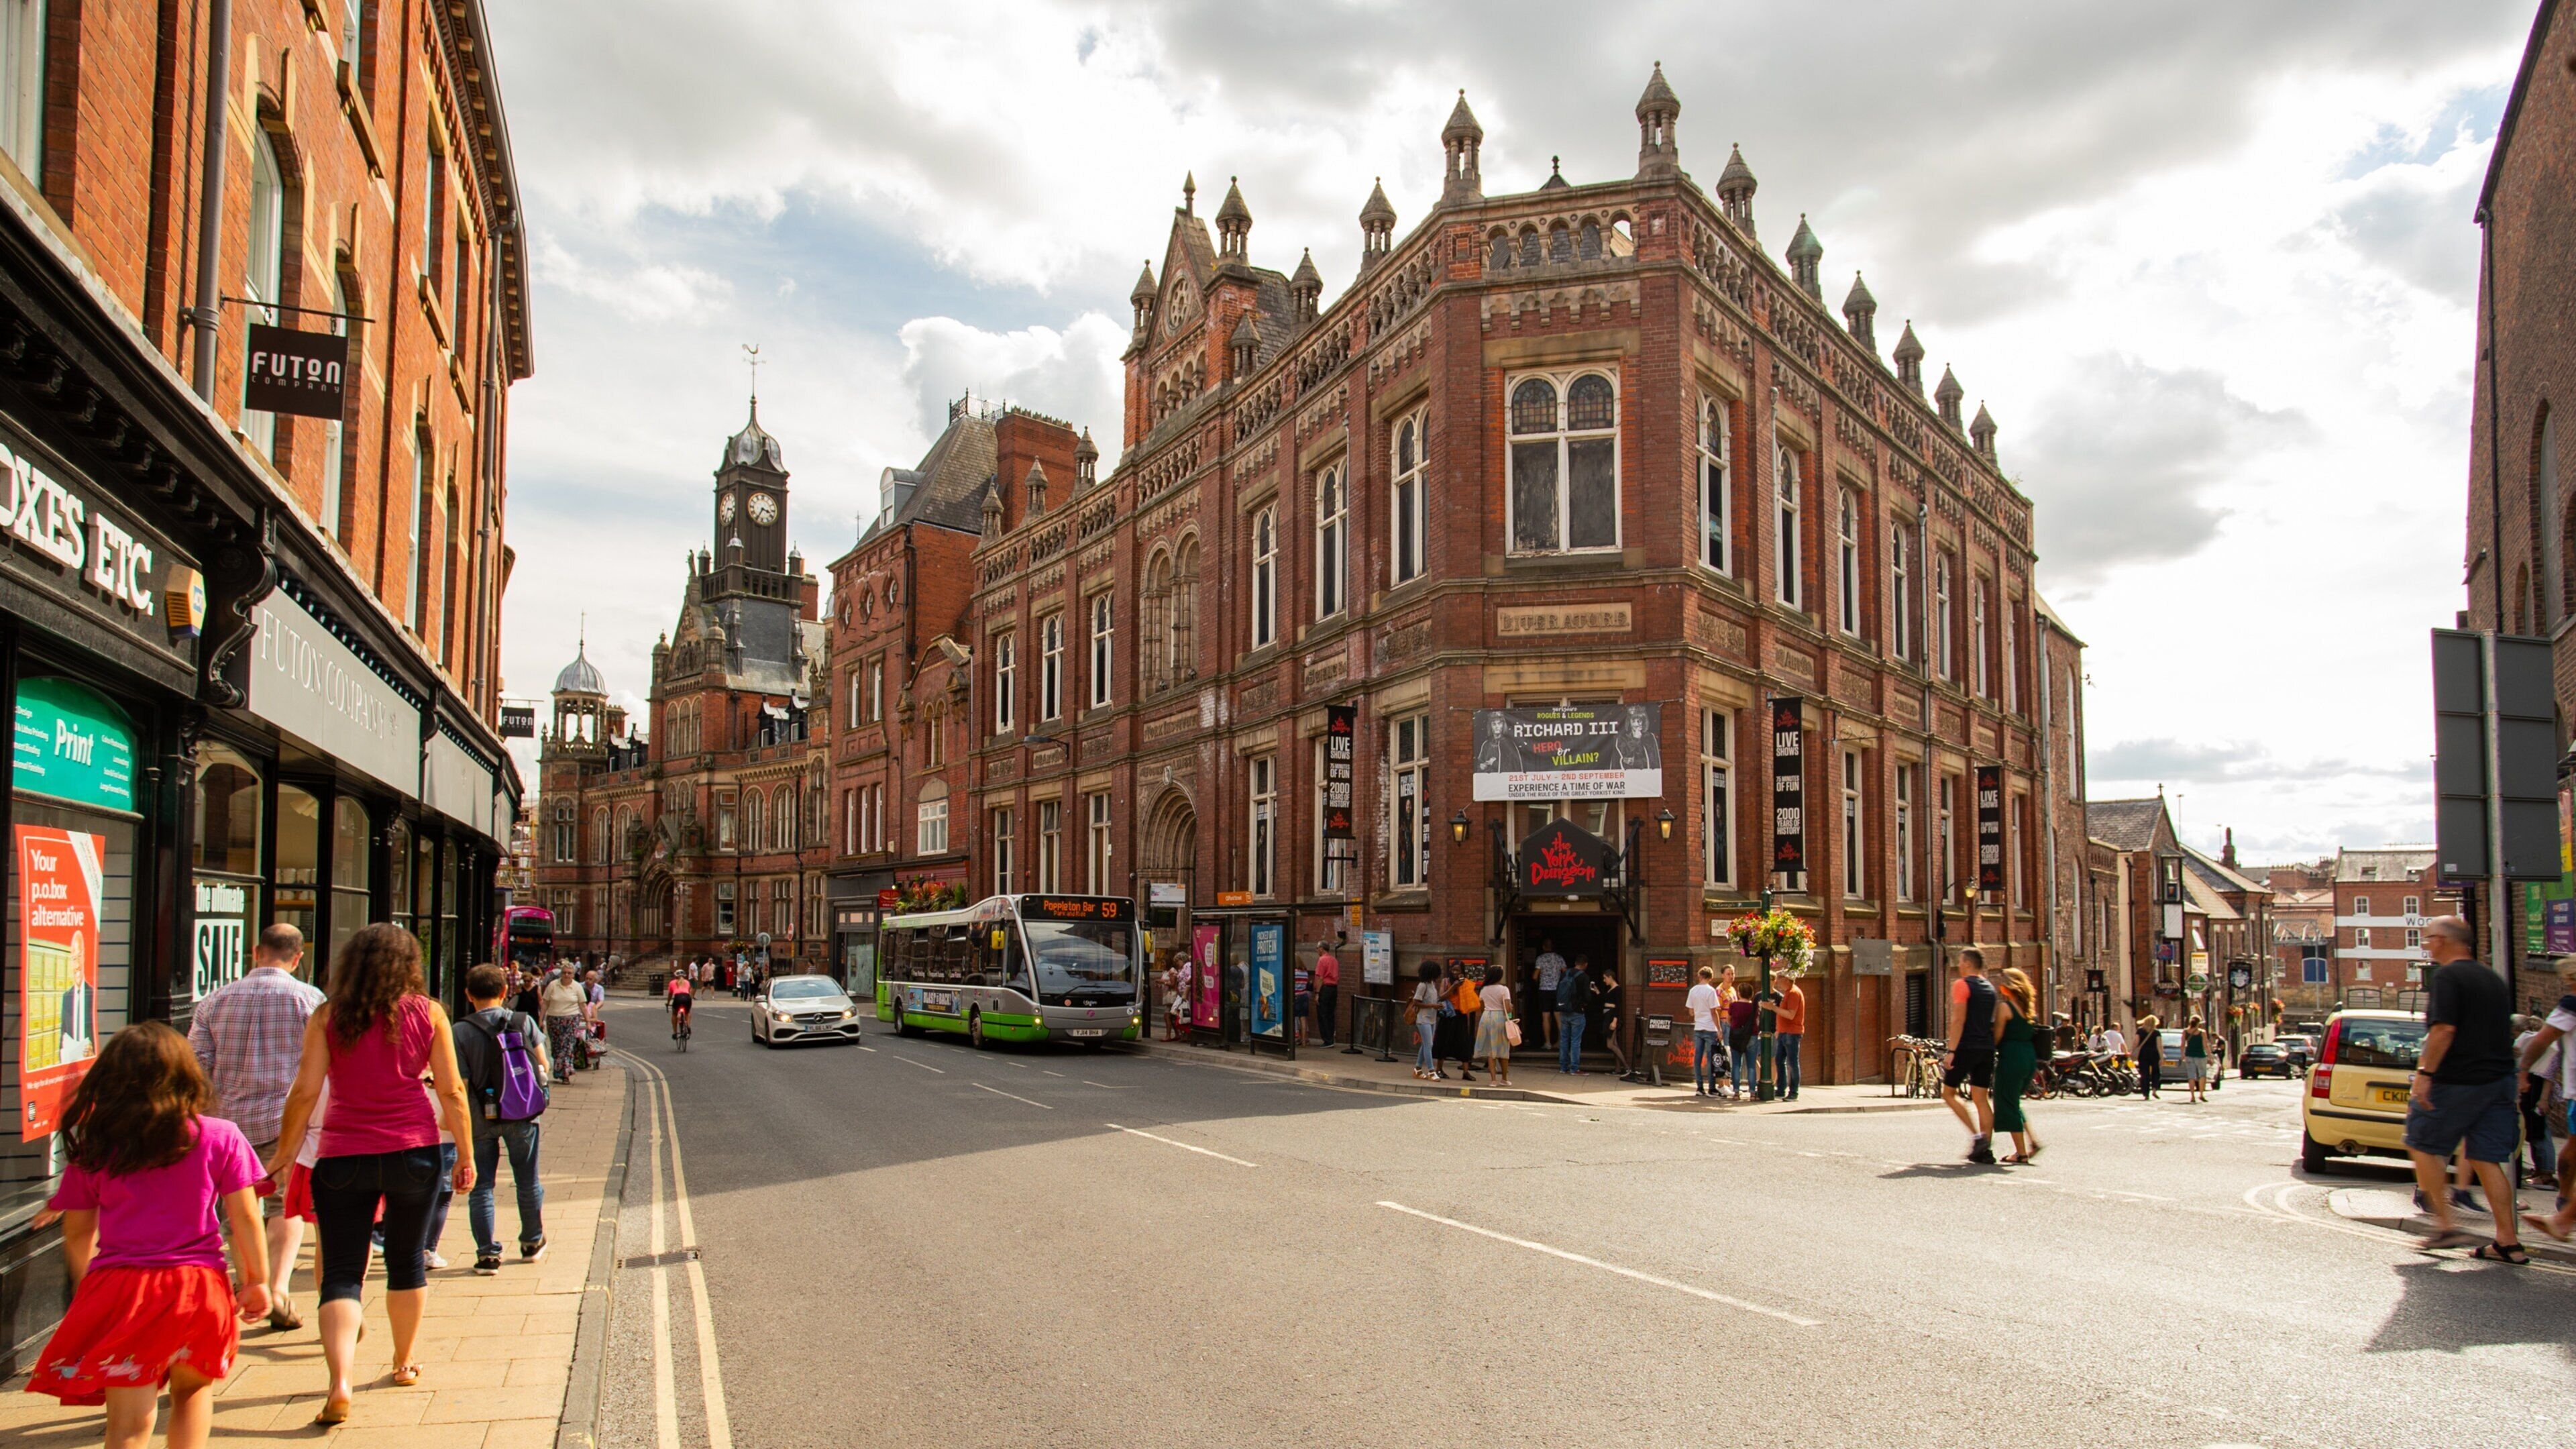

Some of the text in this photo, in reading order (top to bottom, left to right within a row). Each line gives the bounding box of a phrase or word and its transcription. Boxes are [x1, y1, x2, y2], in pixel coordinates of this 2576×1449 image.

[252, 352, 341, 384] FUTON
[94, 513, 153, 616] ETC.
[261, 608, 386, 739] FUTON COMPANY
[502, 716, 533, 726] FUTON
[1514, 721, 1618, 737] RICHARD III
[54, 718, 94, 766] Print
[1331, 737, 1350, 751] LIVE
[1776, 732, 1799, 747] LIVE
[1533, 741, 1562, 753] HERO
[1557, 747, 1570, 756] or
[1776, 747, 1799, 757] SHOWS
[1330, 751, 1350, 760] SHOWS
[1552, 752, 1599, 766] VILLAIN?
[1330, 769, 1350, 779] OF FUN
[1330, 782, 1349, 794] 2000
[1509, 781, 1625, 792] EXPERIENCE A TIME OF WAR
[1776, 782, 1799, 792] OF FUN
[1980, 790, 1998, 802] LIVE
[1330, 800, 1349, 808] HISTORY
[1777, 808, 1800, 820] 2000
[1794, 819, 1800, 827] OF
[1981, 826, 1998, 834] OF FUN
[1777, 826, 1800, 835] HISTORY
[1552, 831, 1572, 851] the
[1981, 845, 1999, 854] 2000
[30, 849, 58, 872] Your
[1541, 848, 1583, 867] York
[1531, 862, 1595, 887] Dungeon
[32, 877, 68, 903] p.o.box
[197, 882, 245, 913] the ultimate
[32, 904, 85, 926] alternative
[1043, 900, 1117, 918] Poppleton Bar 59
[1257, 940, 1277, 955] PROTEIN
[199, 924, 240, 997] SALE
